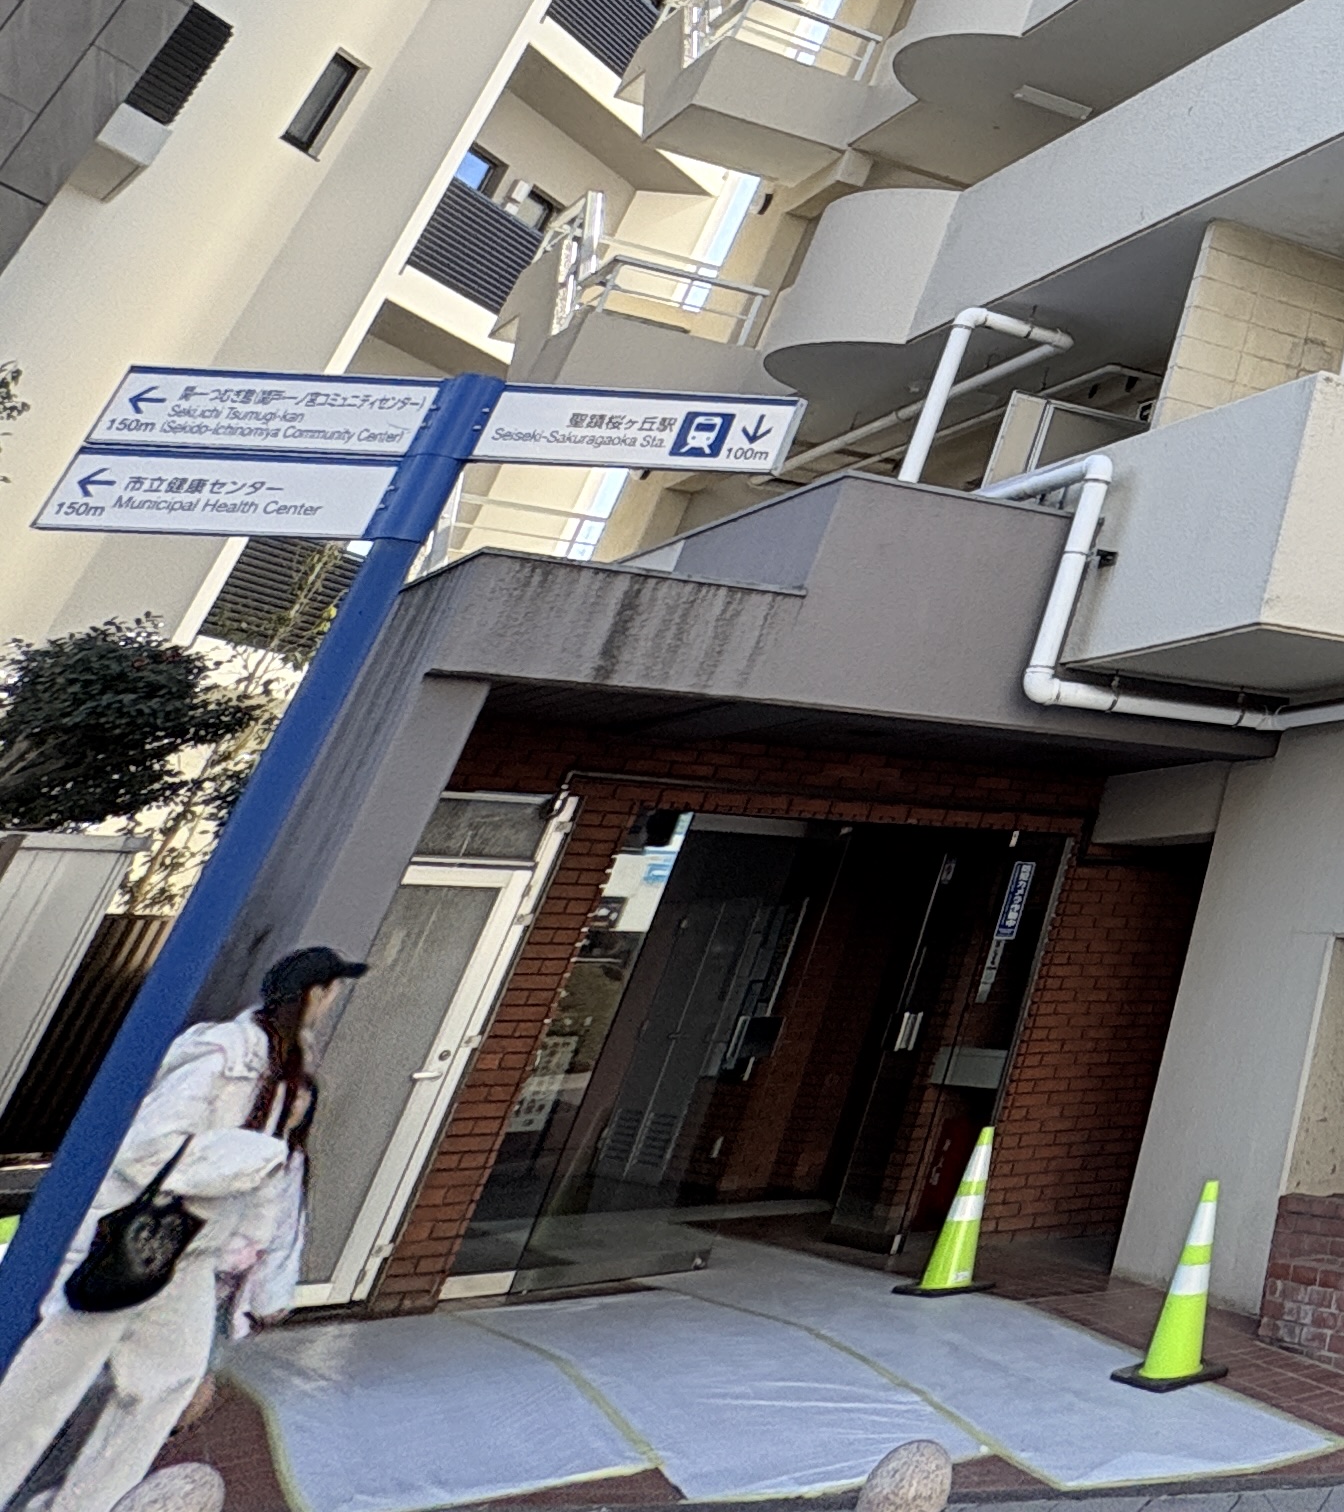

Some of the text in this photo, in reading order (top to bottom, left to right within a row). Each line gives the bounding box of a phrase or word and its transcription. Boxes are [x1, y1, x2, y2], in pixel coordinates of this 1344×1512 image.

[106, 418, 155, 432] 150m
[282, 425, 356, 445] Community
[491, 427, 667, 448] Seiseki-Sakuragaoka Sta.
[724, 448, 769, 461] 100m
[123, 474, 284, 496] 市立健康センター
[54, 501, 106, 517] 150m
[112, 494, 323, 517] Municipal Health Center
